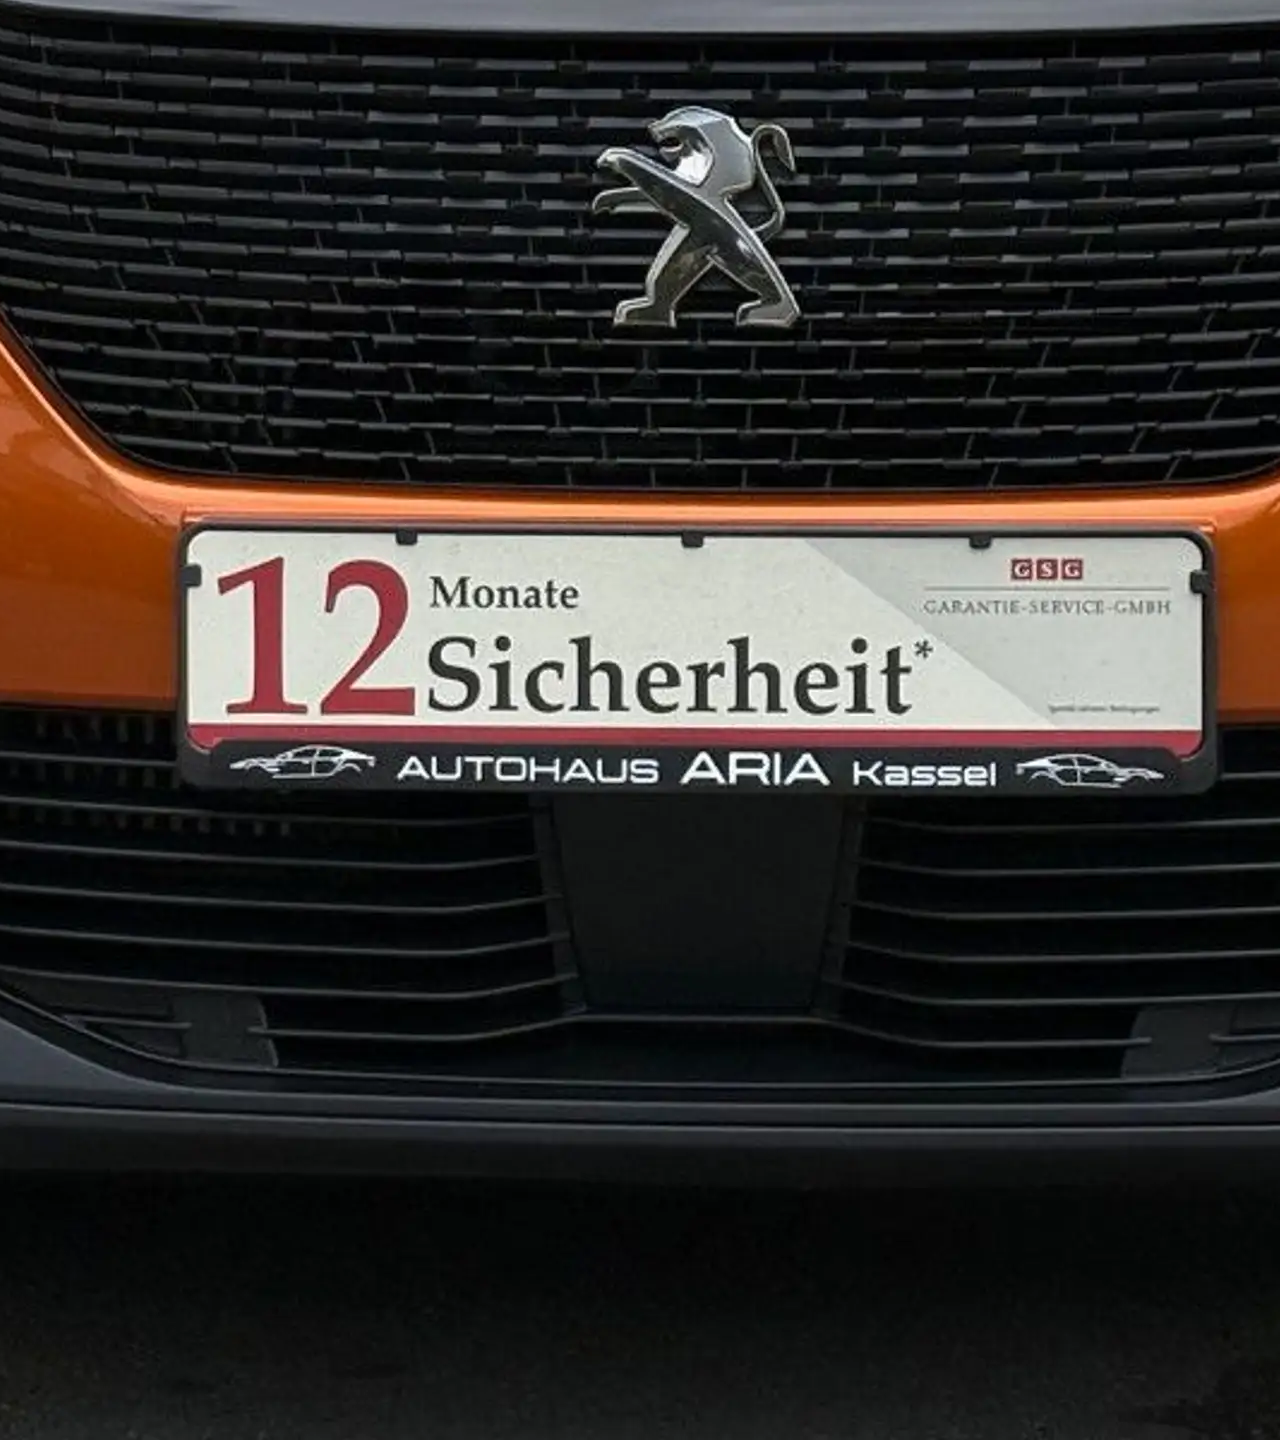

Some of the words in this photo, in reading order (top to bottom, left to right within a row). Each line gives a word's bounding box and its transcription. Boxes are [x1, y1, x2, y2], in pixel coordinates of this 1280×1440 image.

[1012, 560, 1082, 579] GSG
[429, 575, 580, 610] Monate
[217, 556, 416, 715] 12
[397, 756, 659, 783] AUTOHAUS
[679, 751, 830, 786] ARIA
[852, 760, 996, 787] Kassel
